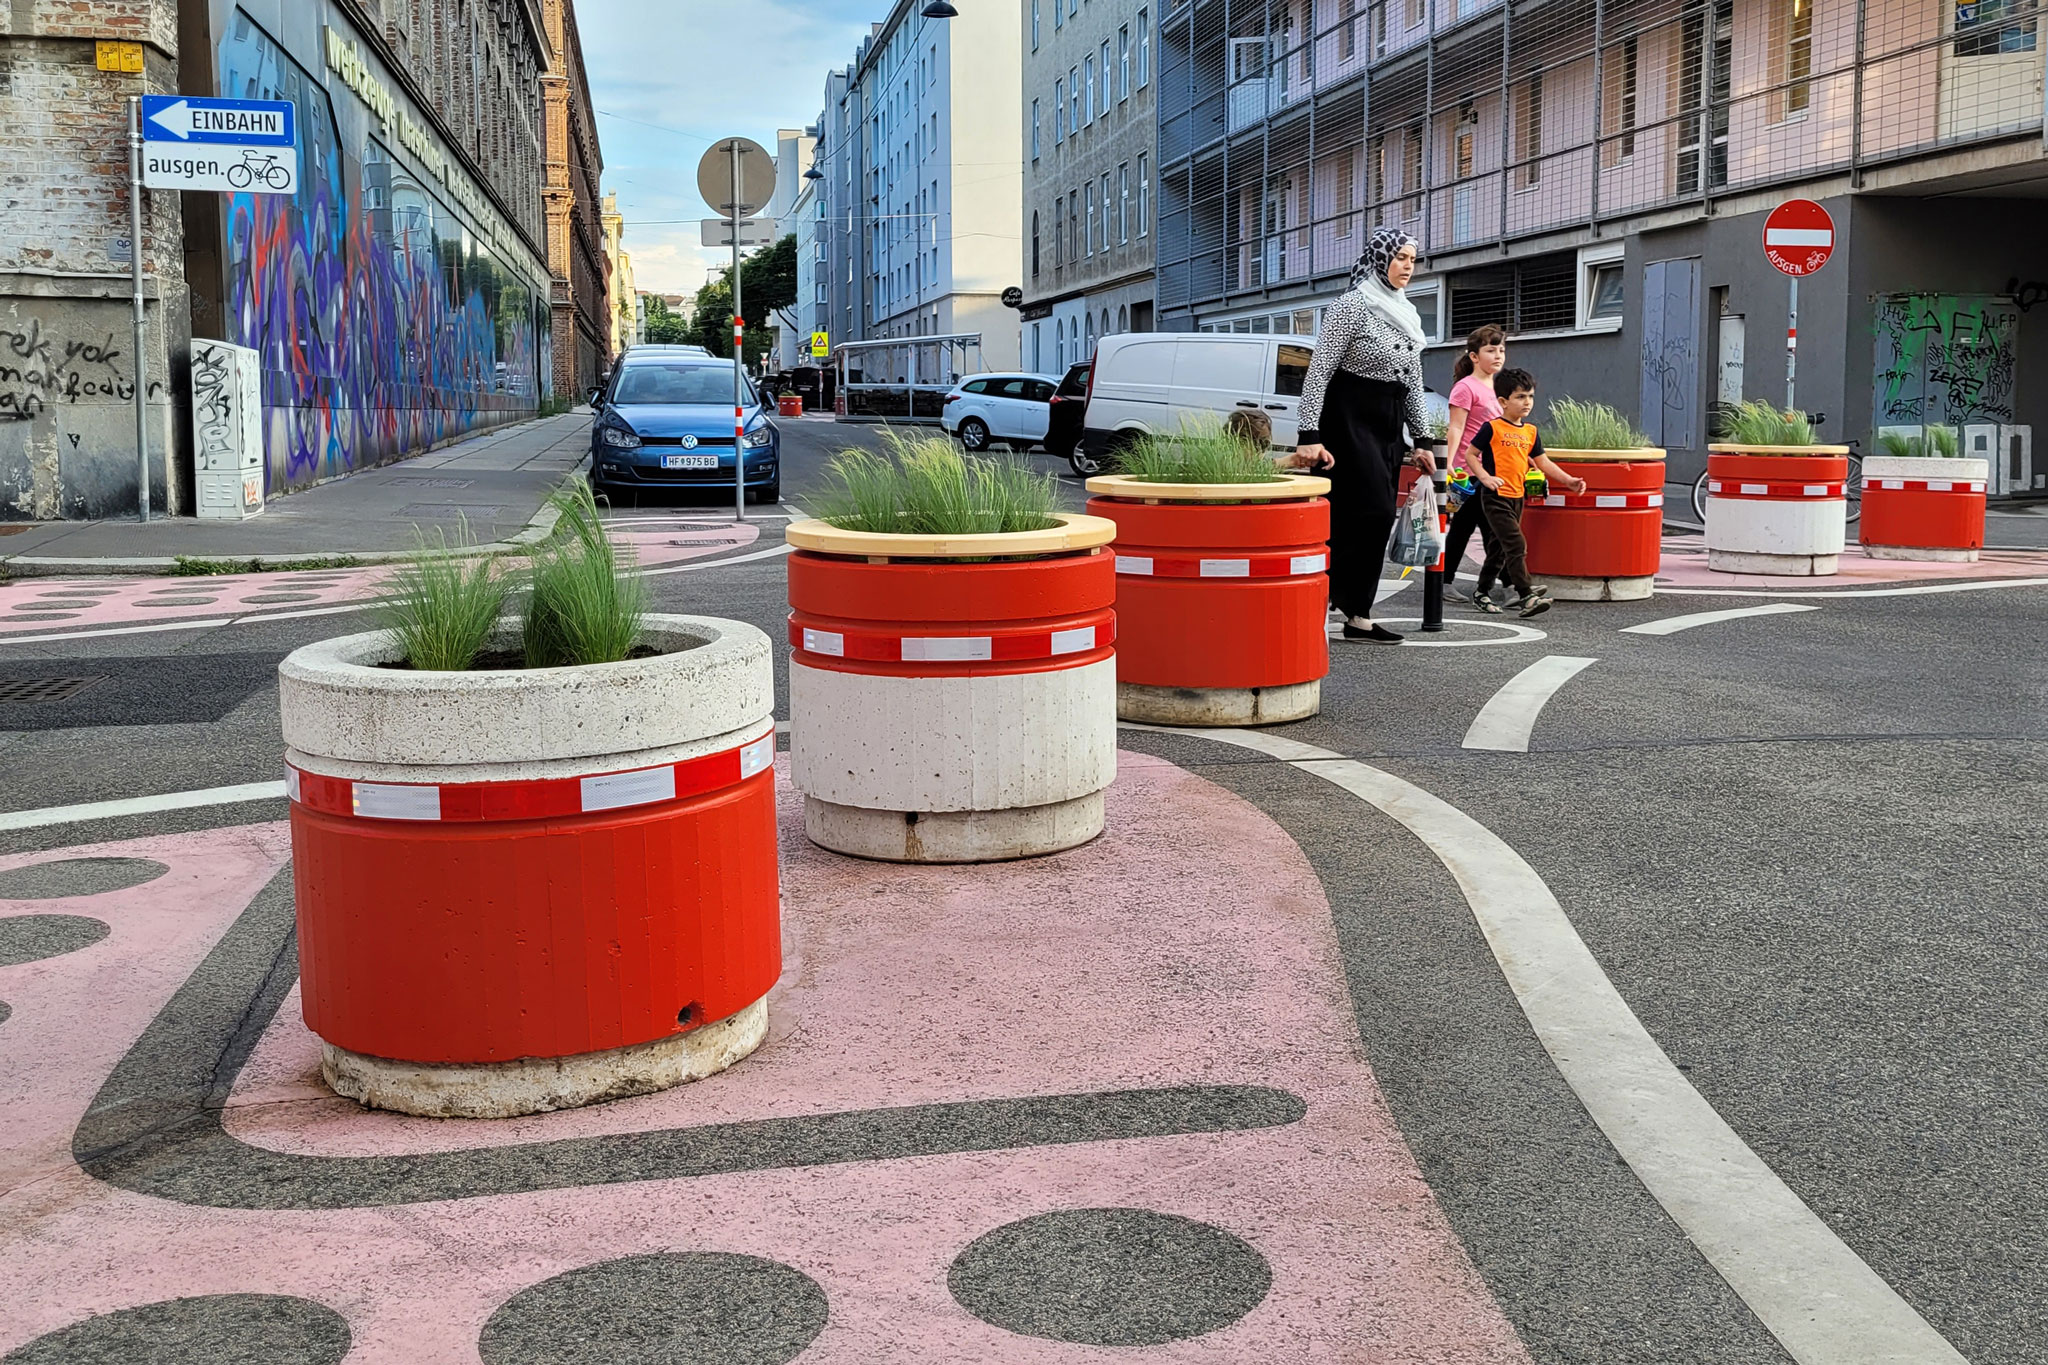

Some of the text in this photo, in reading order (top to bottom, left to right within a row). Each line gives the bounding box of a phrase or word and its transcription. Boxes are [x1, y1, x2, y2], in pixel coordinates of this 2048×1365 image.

[192, 110, 276, 133] EINBAHN
[149, 158, 225, 179] ausgen.
[1767, 249, 1805, 274] AUSGEN.
[668, 457, 715, 466] HF 975 BG
